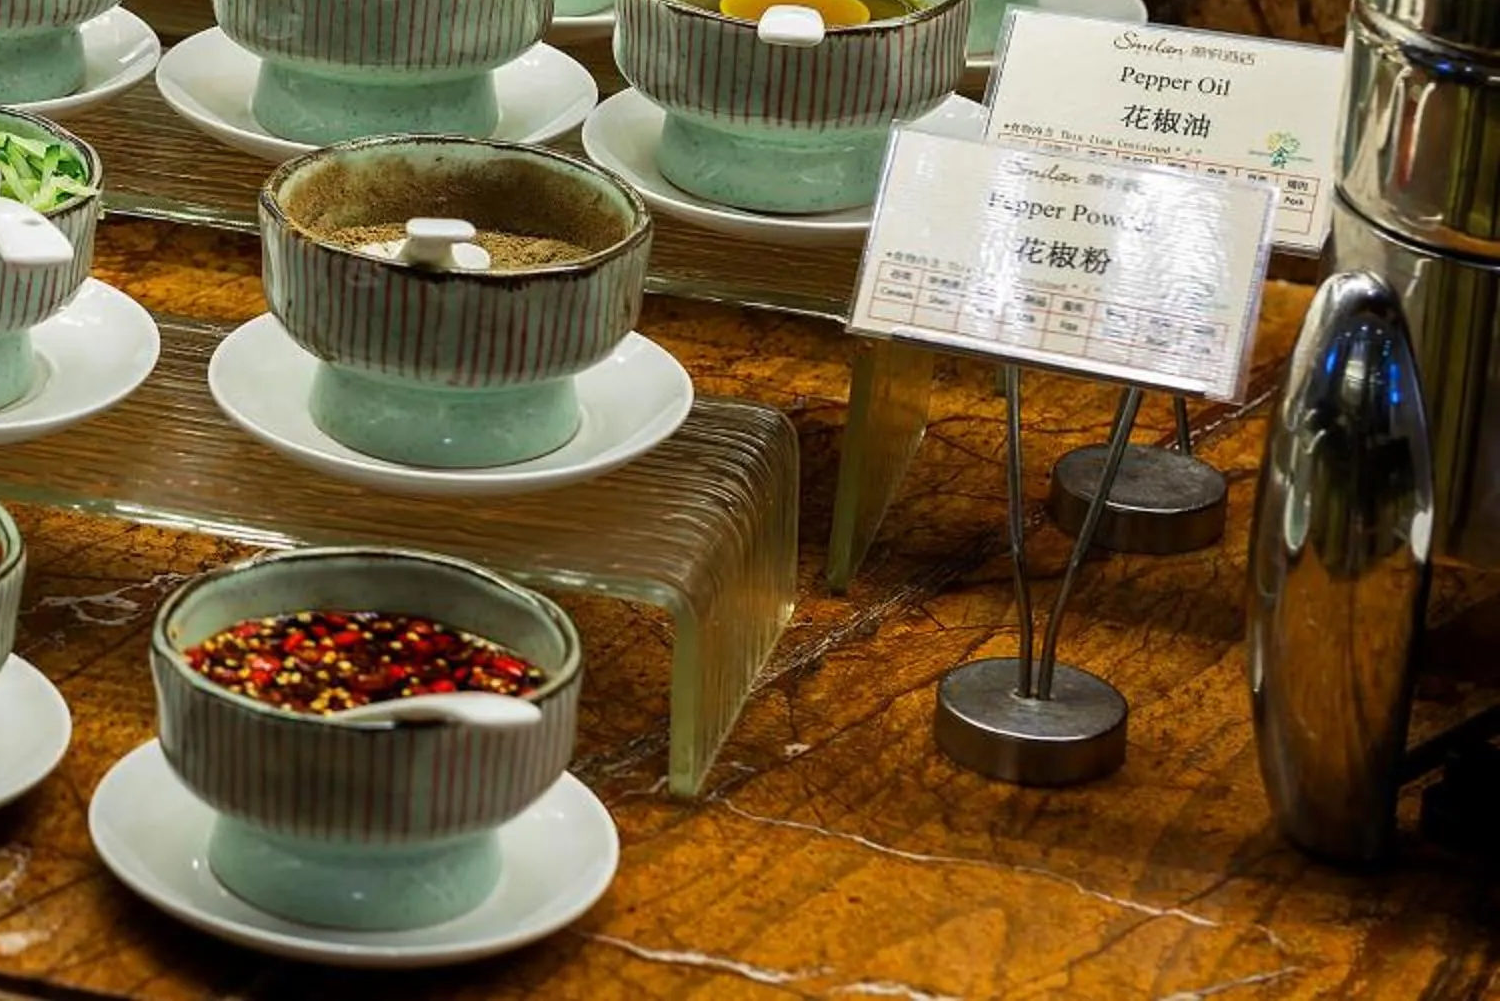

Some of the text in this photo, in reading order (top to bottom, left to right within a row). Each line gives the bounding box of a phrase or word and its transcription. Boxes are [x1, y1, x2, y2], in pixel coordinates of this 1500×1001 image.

[1120, 66, 1231, 97] Pepper Oil
[1120, 103, 1211, 139] 花椒油
[1070, 203, 1155, 234] Powe
[1015, 236, 1112, 276] 花椒粉
